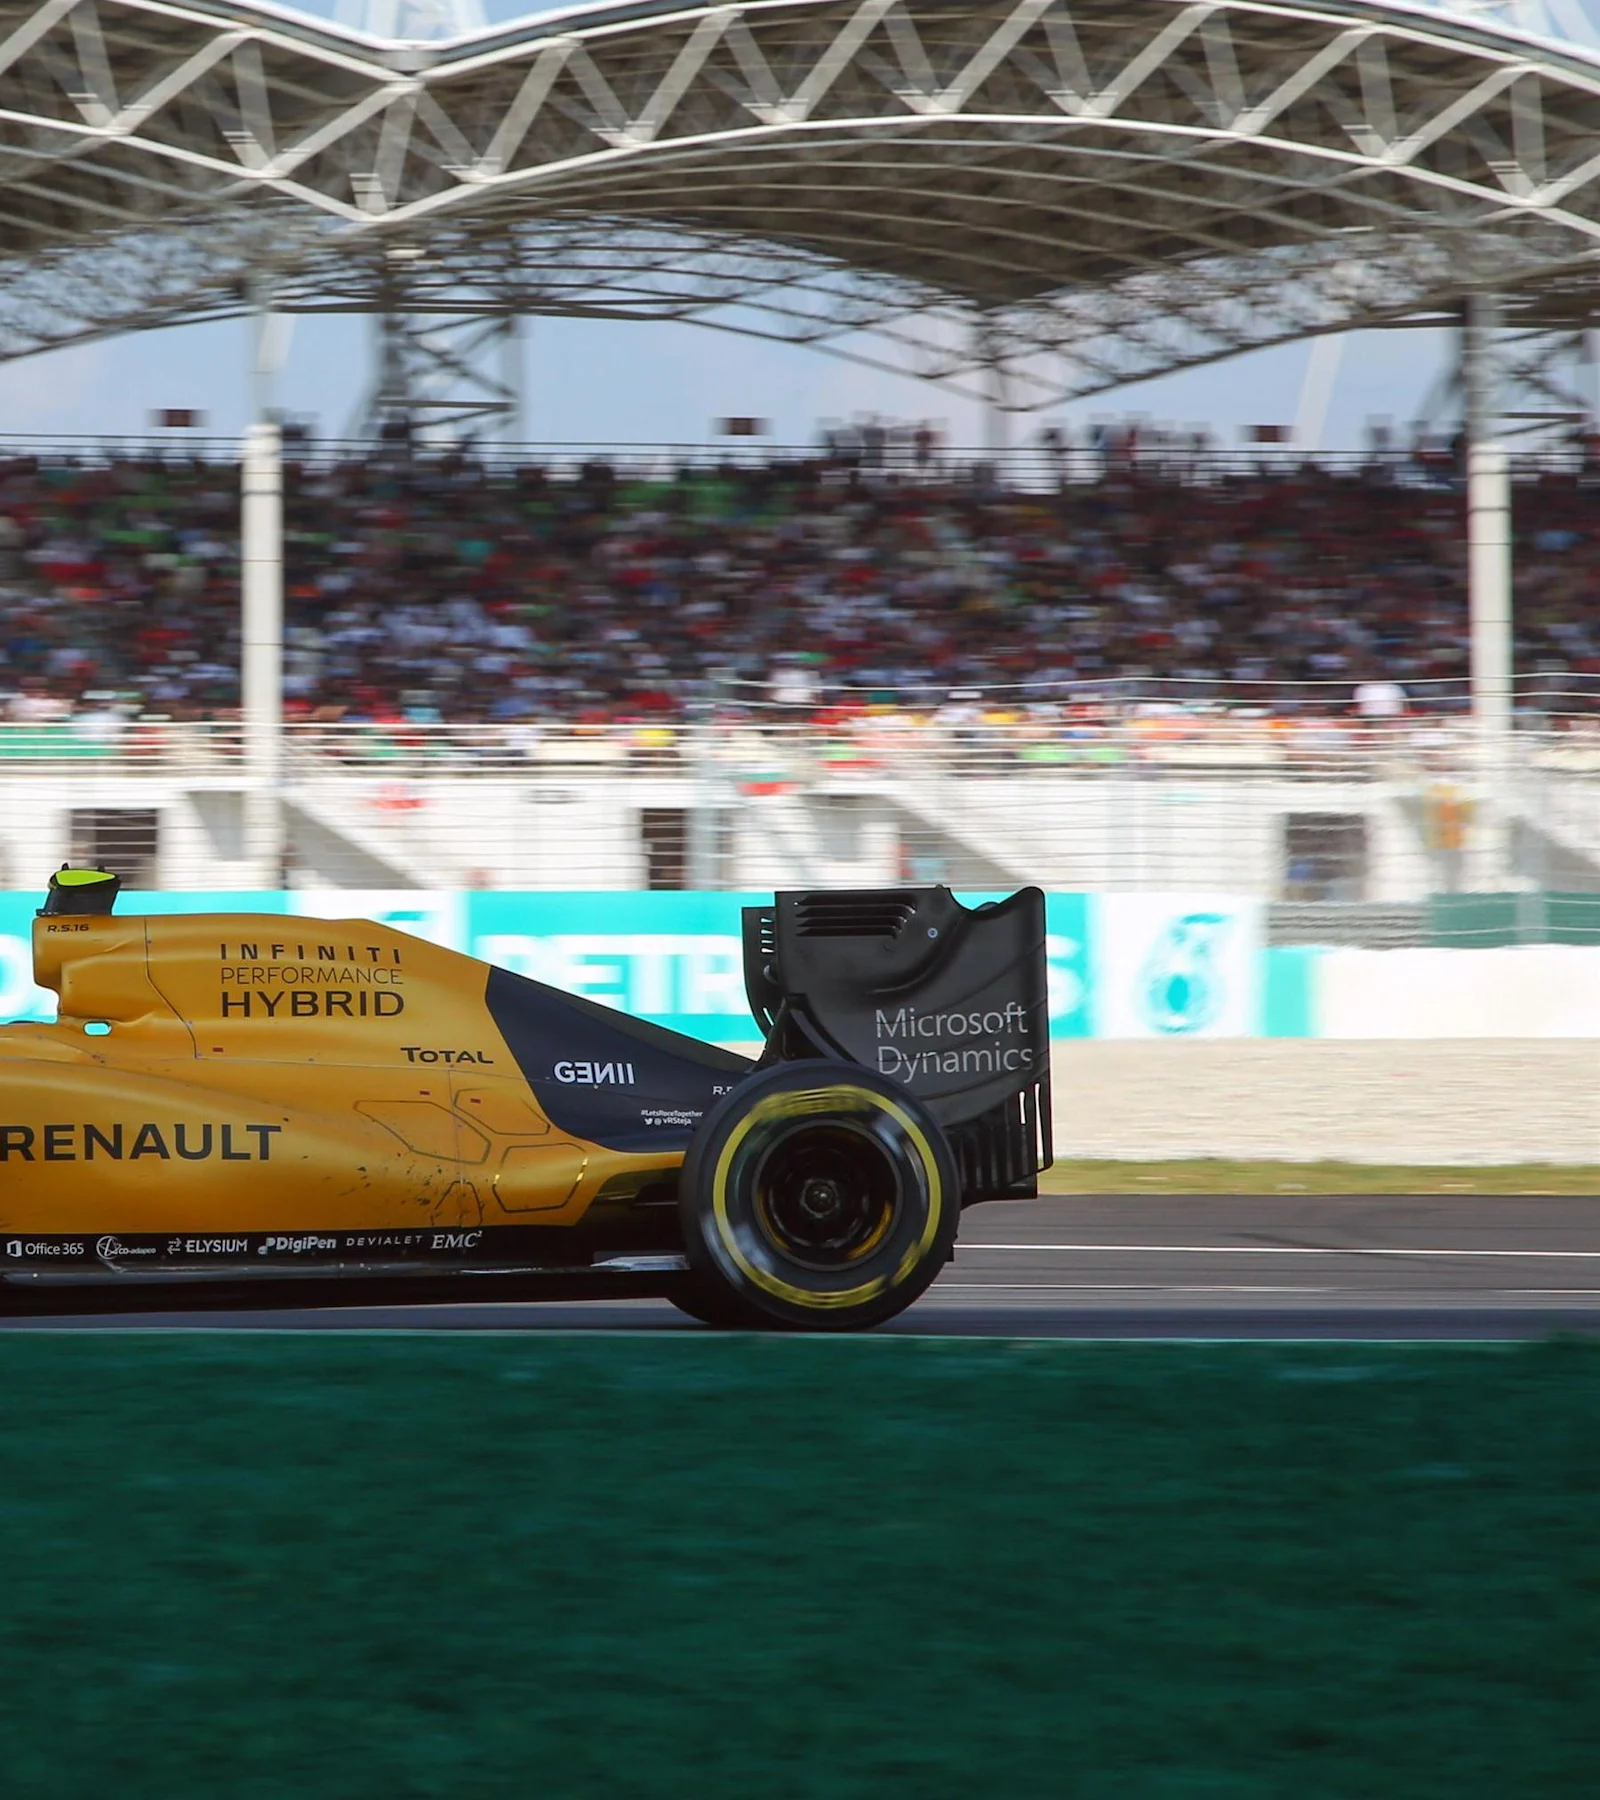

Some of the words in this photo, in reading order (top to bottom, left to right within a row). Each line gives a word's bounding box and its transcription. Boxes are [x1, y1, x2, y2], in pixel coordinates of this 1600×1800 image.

[47, 924, 89, 933] R.S.16
[220, 943, 401, 964] INFINITI
[220, 967, 404, 985] PERFORMANCE
[222, 991, 405, 1018] HYBRID
[875, 1001, 1029, 1038] Microsoft
[400, 1047, 494, 1064] TOTAL
[877, 1041, 1034, 1084] Dynamics
[25, 1242, 61, 1255] Office
[62, 1242, 84, 1255] 365
[185, 1239, 248, 1253] ELYSIUM
[276, 1236, 337, 1253] DigiPen
[346, 1235, 422, 1247] DEVIALET
